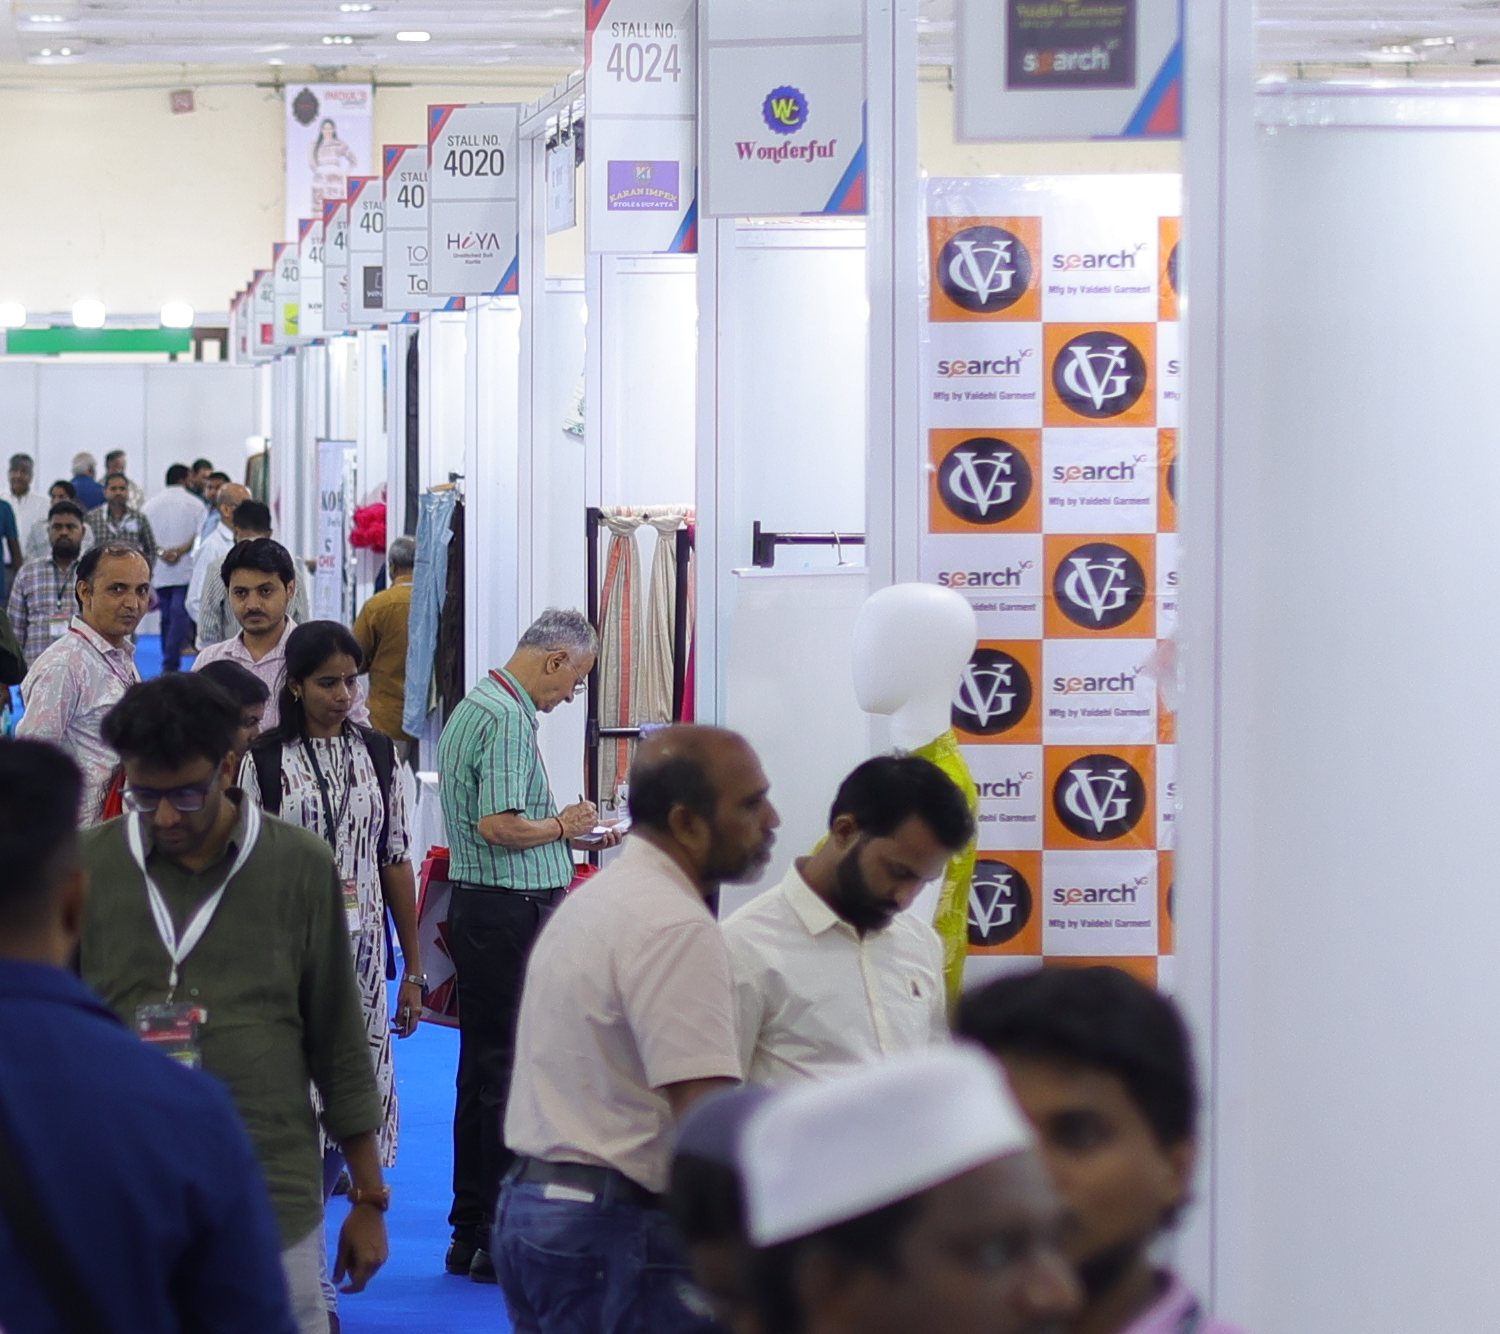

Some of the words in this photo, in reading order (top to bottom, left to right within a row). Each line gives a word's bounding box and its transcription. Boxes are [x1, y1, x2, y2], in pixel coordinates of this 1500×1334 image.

[611, 22, 651, 38] STALL
[654, 22, 677, 39] NO.
[606, 42, 682, 83] 4024
[447, 135, 480, 147] STALL
[482, 134, 501, 147] NO.
[735, 138, 838, 163] Wonderful
[443, 148, 505, 177] 4020
[397, 184, 425, 208] 40
[360, 212, 383, 233] 40
[1051, 249, 1136, 272] search
[1067, 285, 1077, 295] by
[1114, 284, 1151, 294] Garment
[936, 355, 1021, 378] search
[952, 391, 962, 401] by
[999, 391, 1037, 401] Garment
[1051, 461, 1136, 484] search
[1067, 496, 1077, 507] by
[1114, 496, 1151, 506] Garment
[937, 565, 1021, 589] search
[972, 602, 997, 612] aidehi
[999, 602, 1037, 612] Garment
[1052, 670, 1135, 695] search
[1067, 708, 1078, 718] by
[1114, 708, 1151, 718] Garment
[999, 813, 1037, 823] Garment
[1052, 881, 1136, 906] search
[1067, 920, 1078, 930] by
[1114, 919, 1151, 929] Garment
